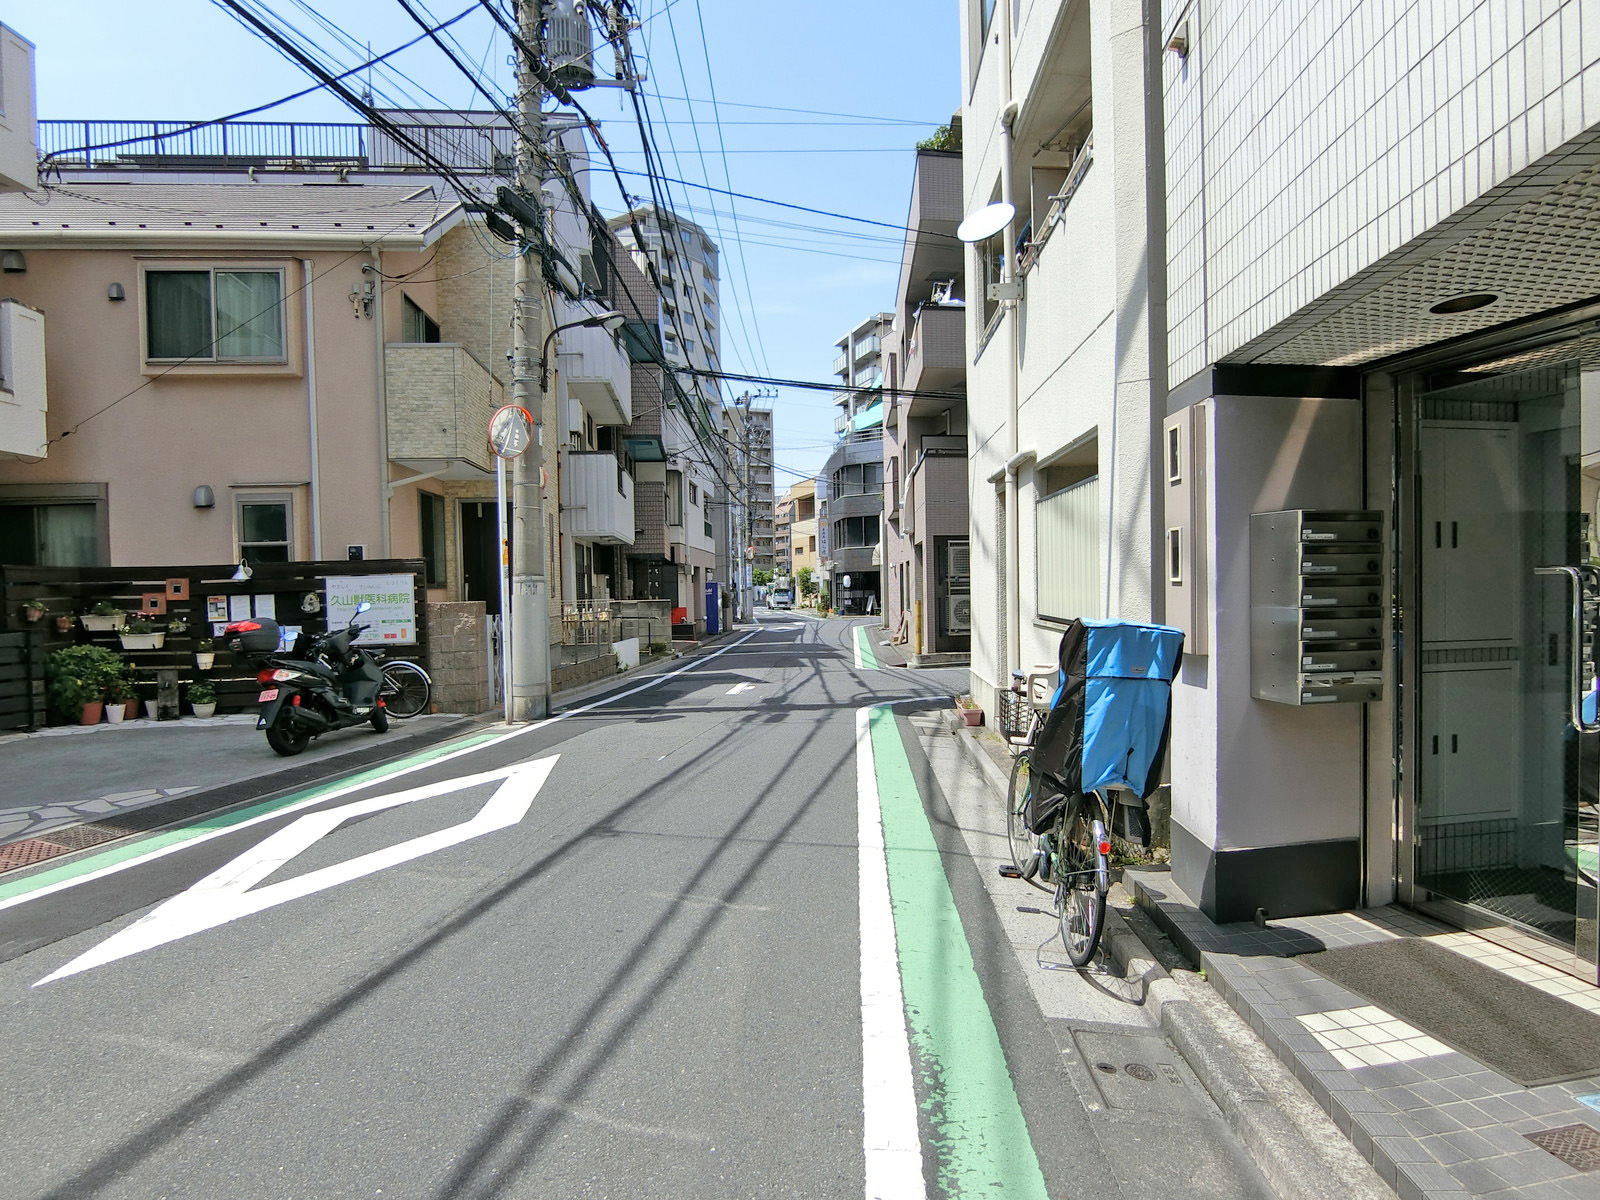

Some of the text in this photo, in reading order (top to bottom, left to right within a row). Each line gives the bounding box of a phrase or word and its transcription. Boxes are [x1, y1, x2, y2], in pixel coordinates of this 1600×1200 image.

[330, 593, 410, 606] 久山獣医科病院
